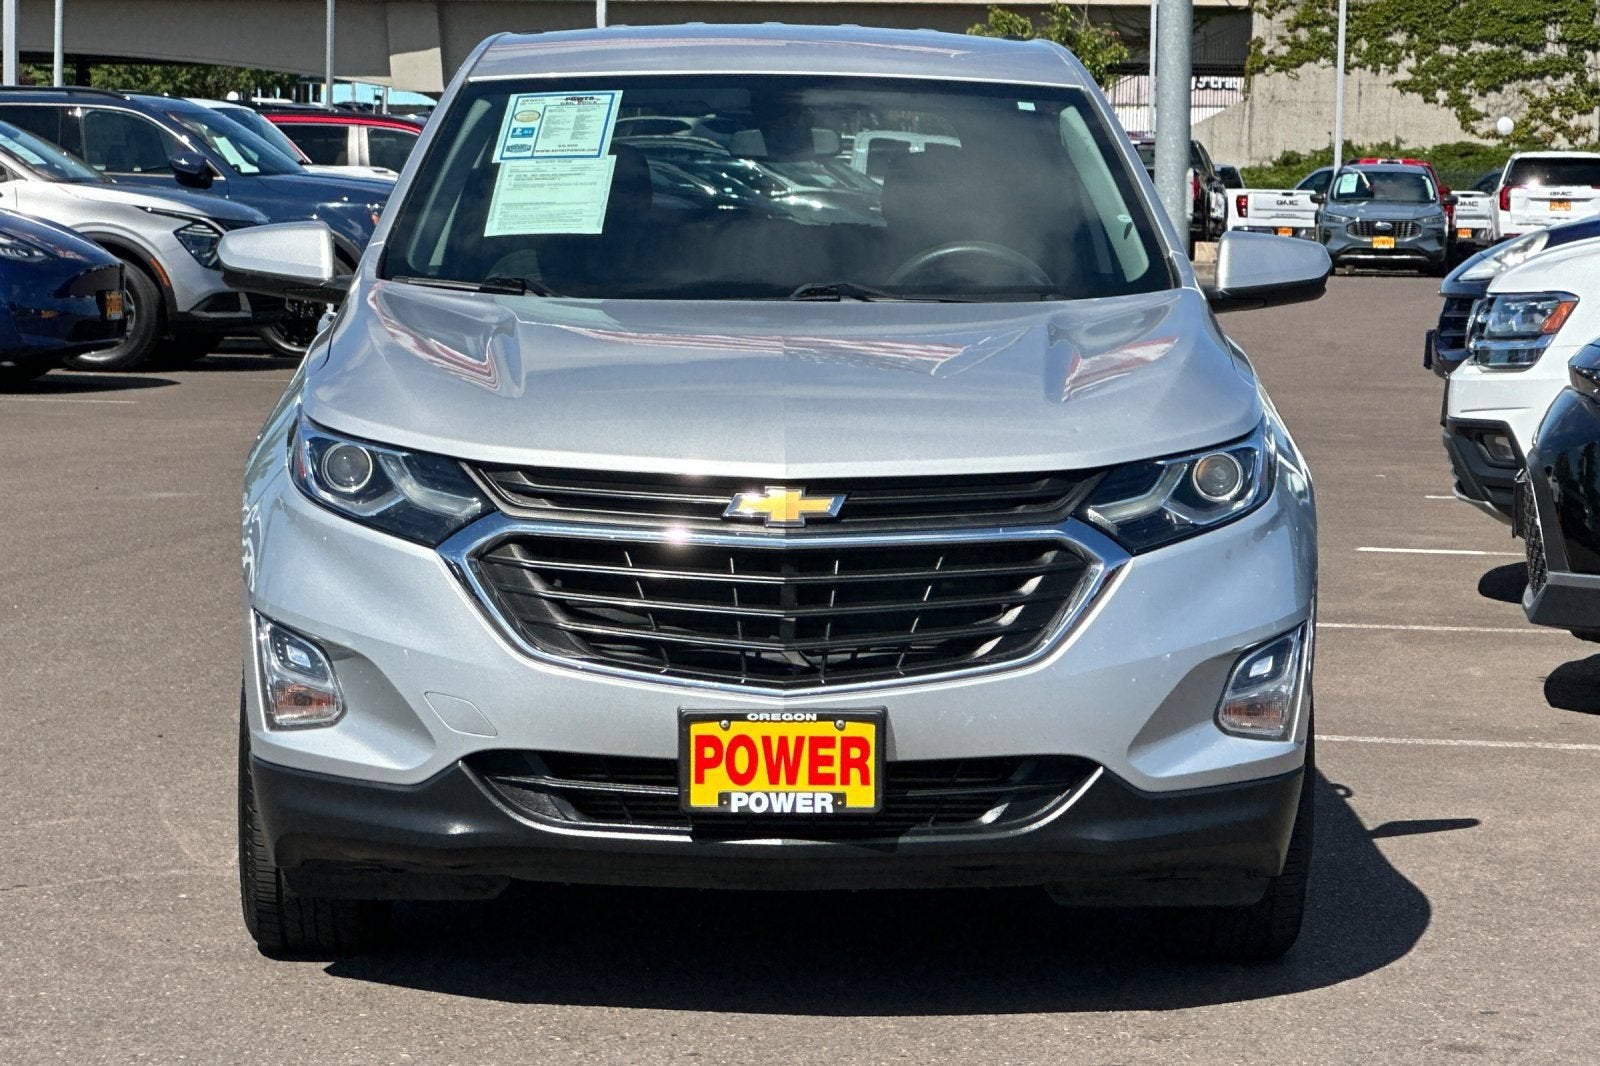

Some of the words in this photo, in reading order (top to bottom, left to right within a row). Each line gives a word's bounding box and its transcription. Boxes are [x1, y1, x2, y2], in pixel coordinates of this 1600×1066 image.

[746, 713, 817, 721] OREGON
[695, 734, 871, 786] POWER
[730, 792, 834, 813] POWER
